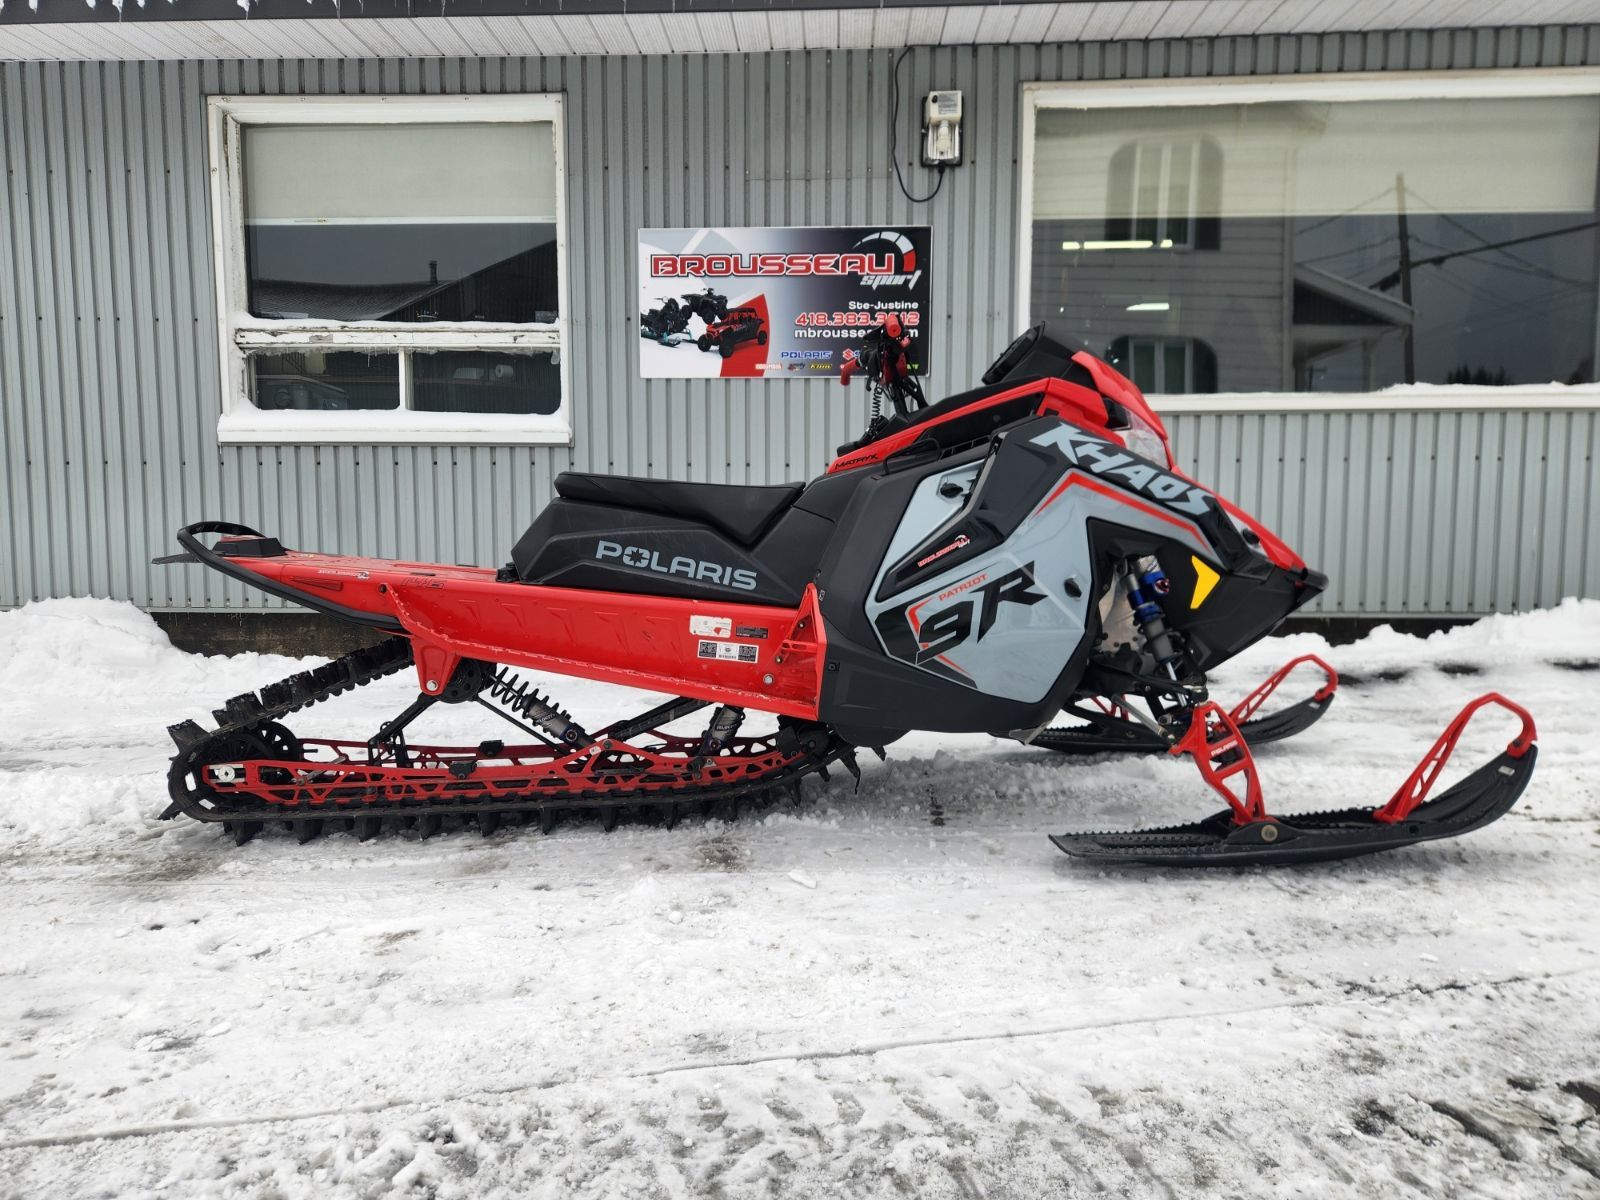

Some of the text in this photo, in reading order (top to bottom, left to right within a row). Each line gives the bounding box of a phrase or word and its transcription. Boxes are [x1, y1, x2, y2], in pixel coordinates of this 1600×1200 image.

[651, 254, 895, 277] BROUSSEAU
[860, 270, 922, 291] sport
[848, 300, 919, 311] Ste-Justine
[781, 350, 833, 360] POLARIS
[1029, 421, 1216, 515] KHAOS
[595, 540, 758, 591] POLARIS
[938, 573, 988, 602] PATRIOT
[916, 560, 1049, 666] 9R
